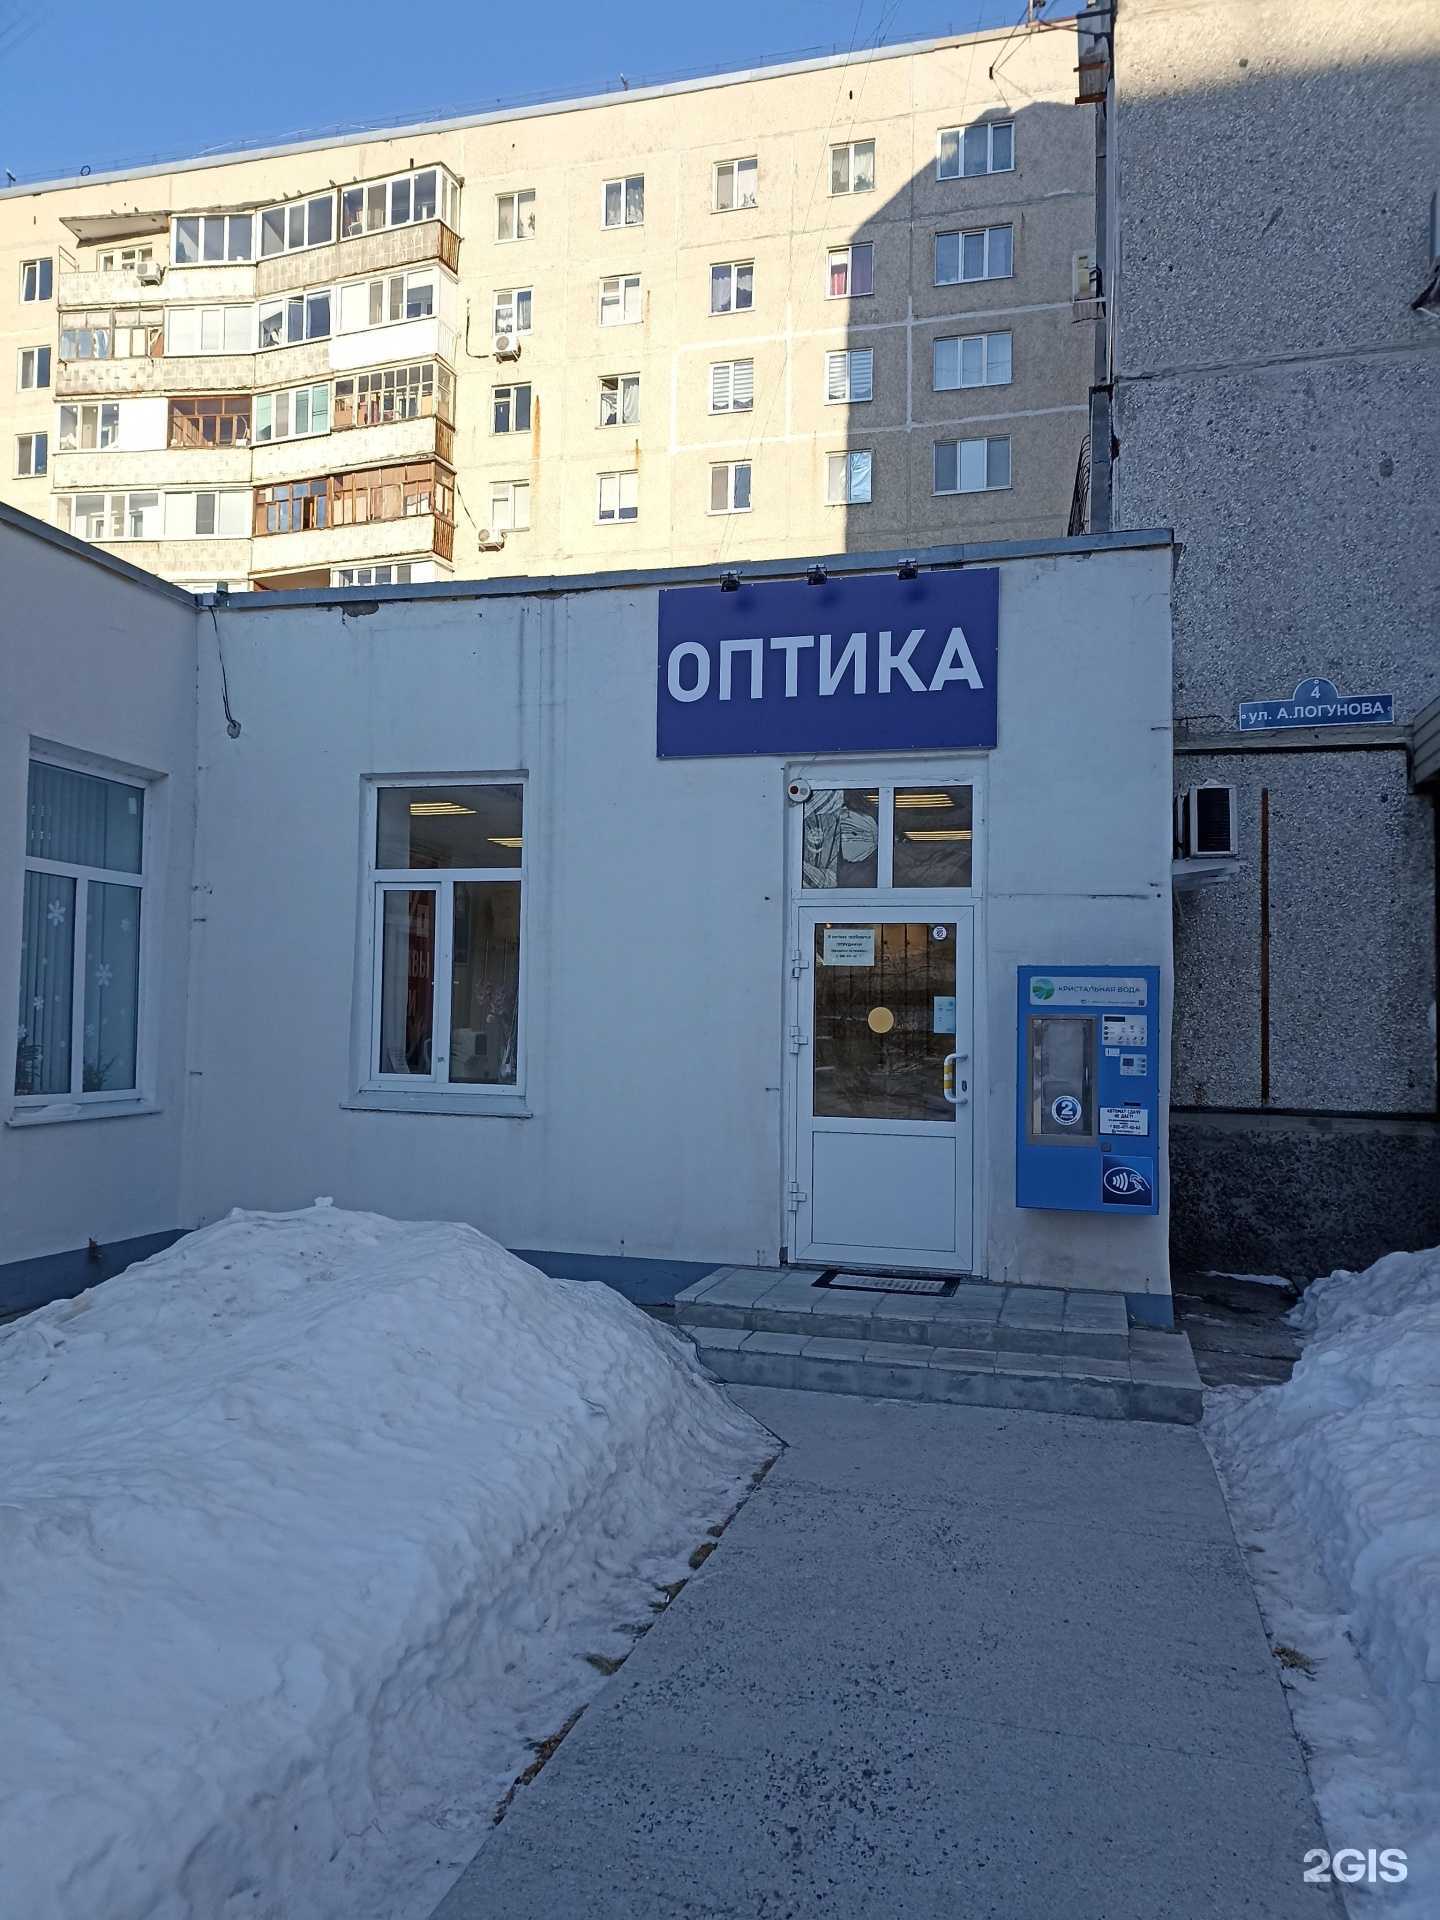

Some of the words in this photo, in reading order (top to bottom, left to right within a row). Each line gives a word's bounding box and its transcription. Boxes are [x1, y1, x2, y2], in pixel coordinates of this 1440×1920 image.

[667, 627, 984, 703] ОПТИКА
[1310, 686, 1320, 698] 4
[1249, 710, 1272, 725] ул.
[1277, 702, 1385, 720] А.ЛОГУНОВА
[1061, 1101, 1073, 1114] 2
